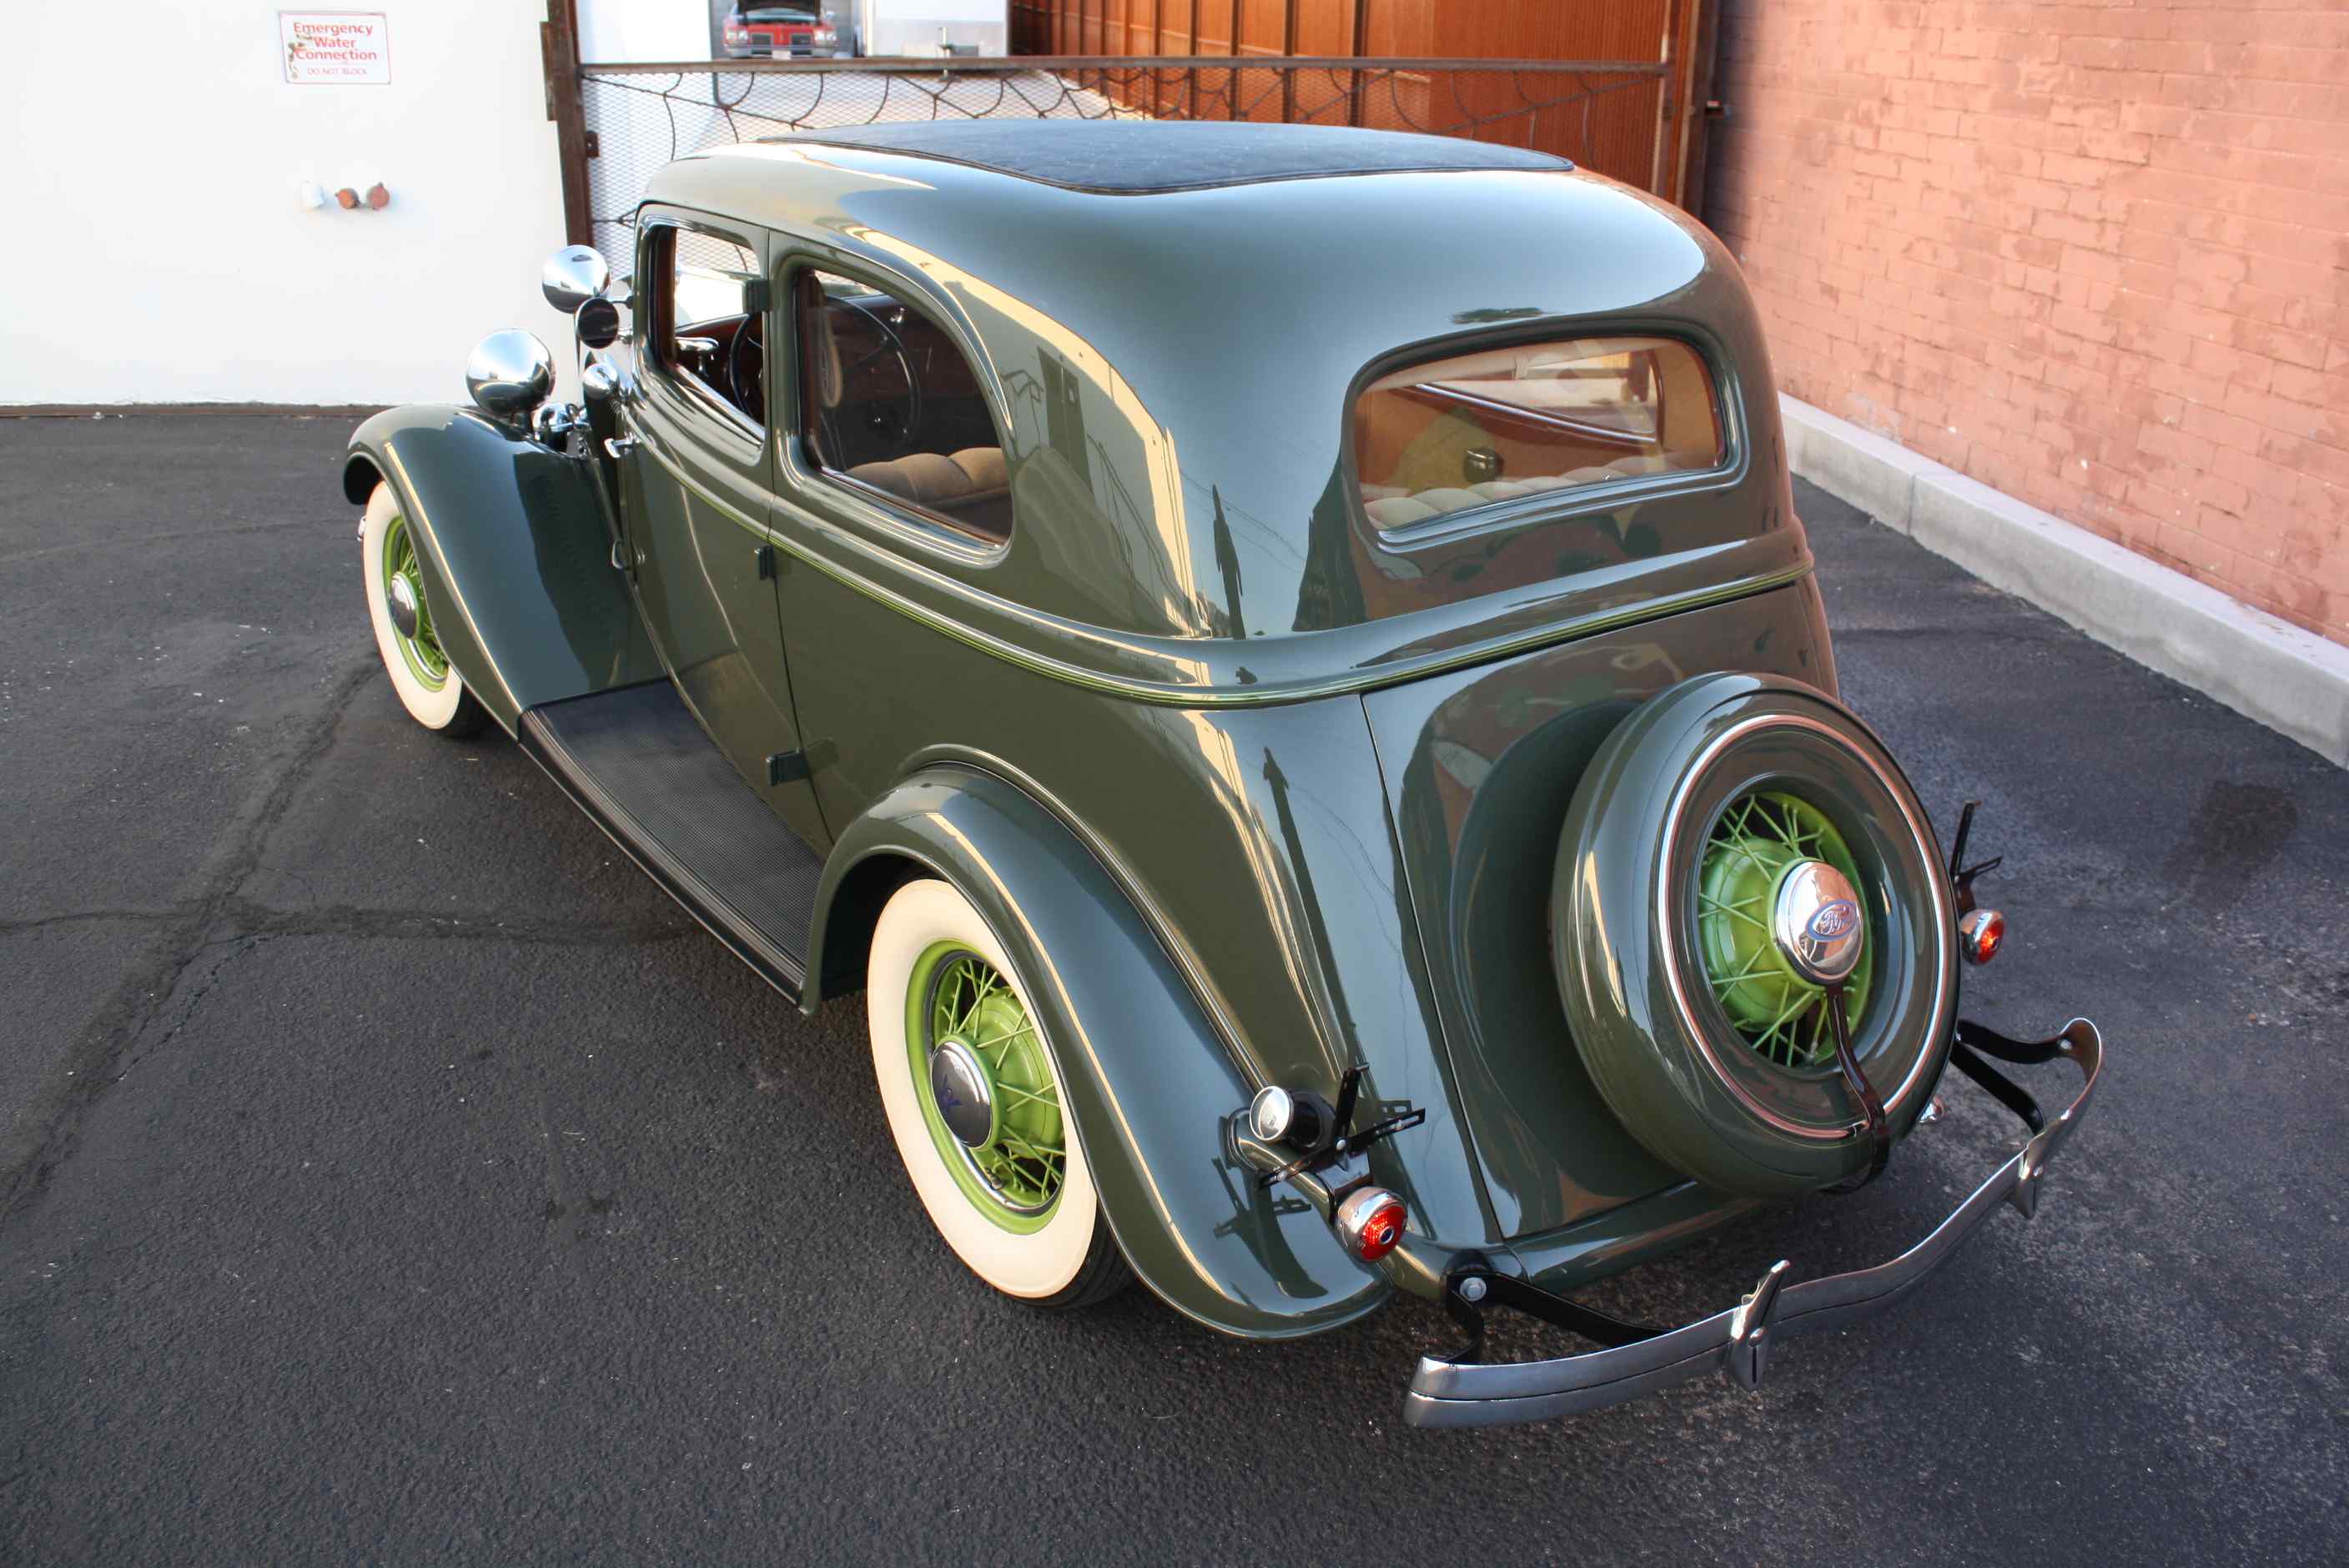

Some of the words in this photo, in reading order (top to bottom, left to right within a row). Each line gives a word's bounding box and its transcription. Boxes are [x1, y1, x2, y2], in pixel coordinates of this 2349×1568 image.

[294, 22, 373, 36] Emergency
[314, 36, 356, 48] Water
[295, 49, 377, 60] Connection
